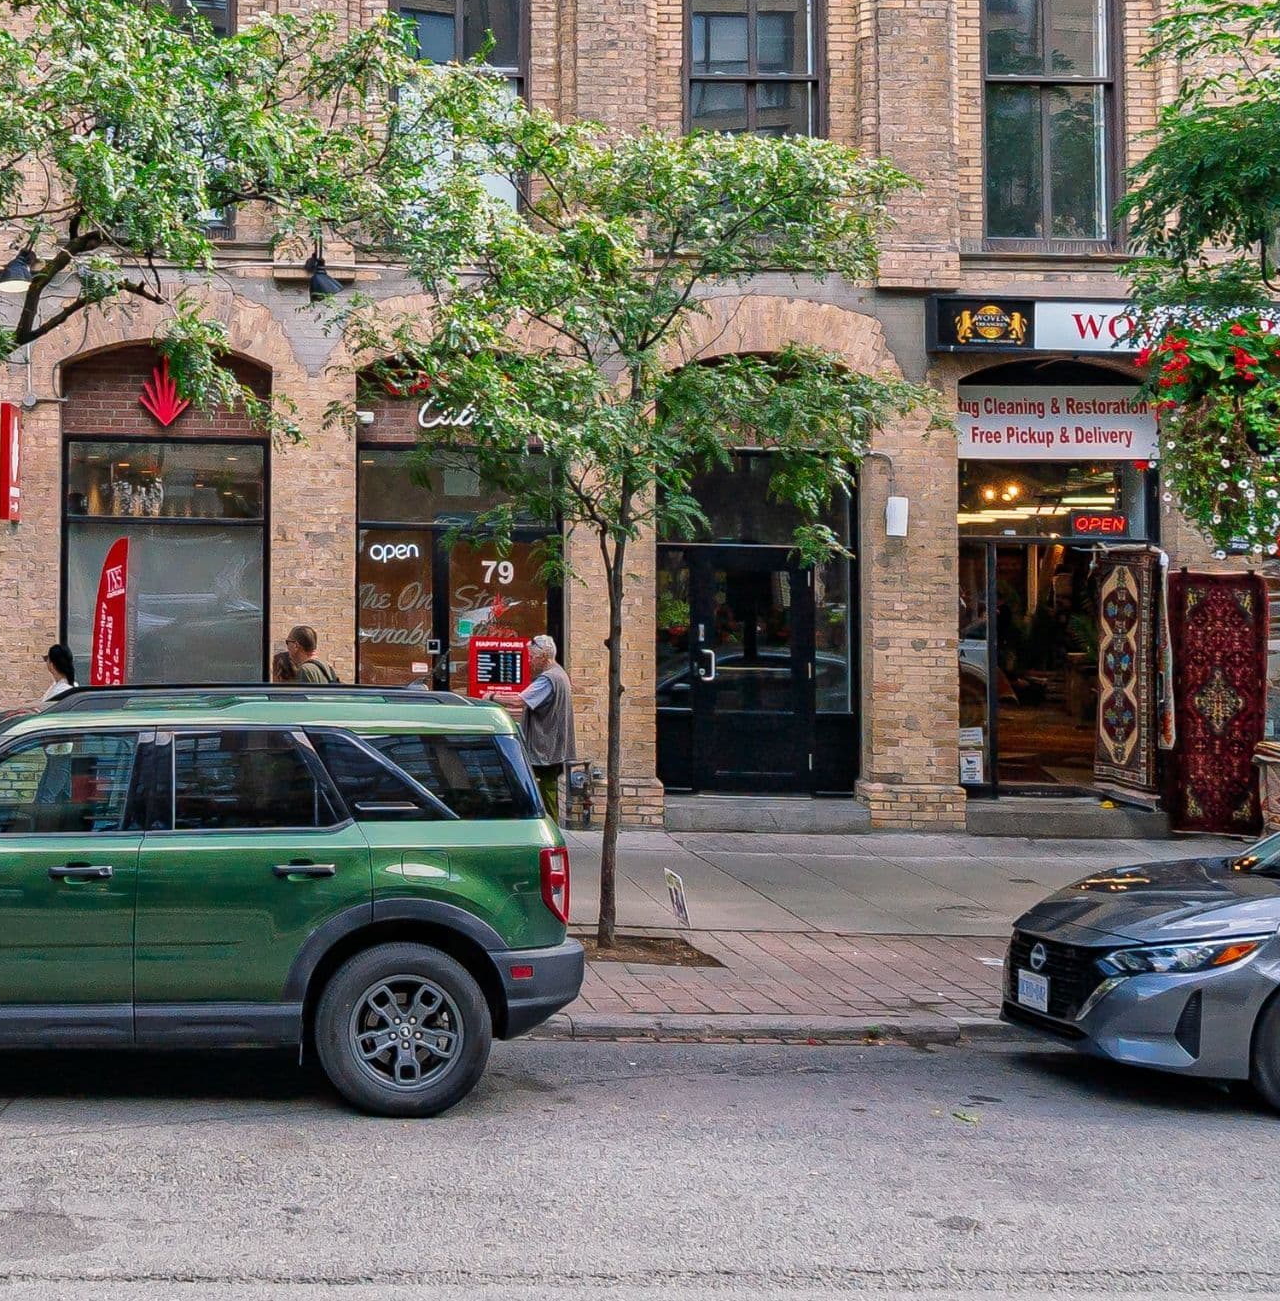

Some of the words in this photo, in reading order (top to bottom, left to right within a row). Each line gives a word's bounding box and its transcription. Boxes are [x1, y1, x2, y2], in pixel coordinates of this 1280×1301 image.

[984, 397, 1045, 418] Cleaning
[1051, 397, 1060, 414] &
[1066, 397, 1148, 414] Restoration
[971, 427, 1001, 444] Free
[1006, 427, 1054, 447] Pickup
[1060, 427, 1069, 443] &
[1075, 427, 1132, 447] Delivery
[1075, 516, 1126, 532] OPEN
[370, 543, 419, 563] open
[481, 560, 514, 584] 79
